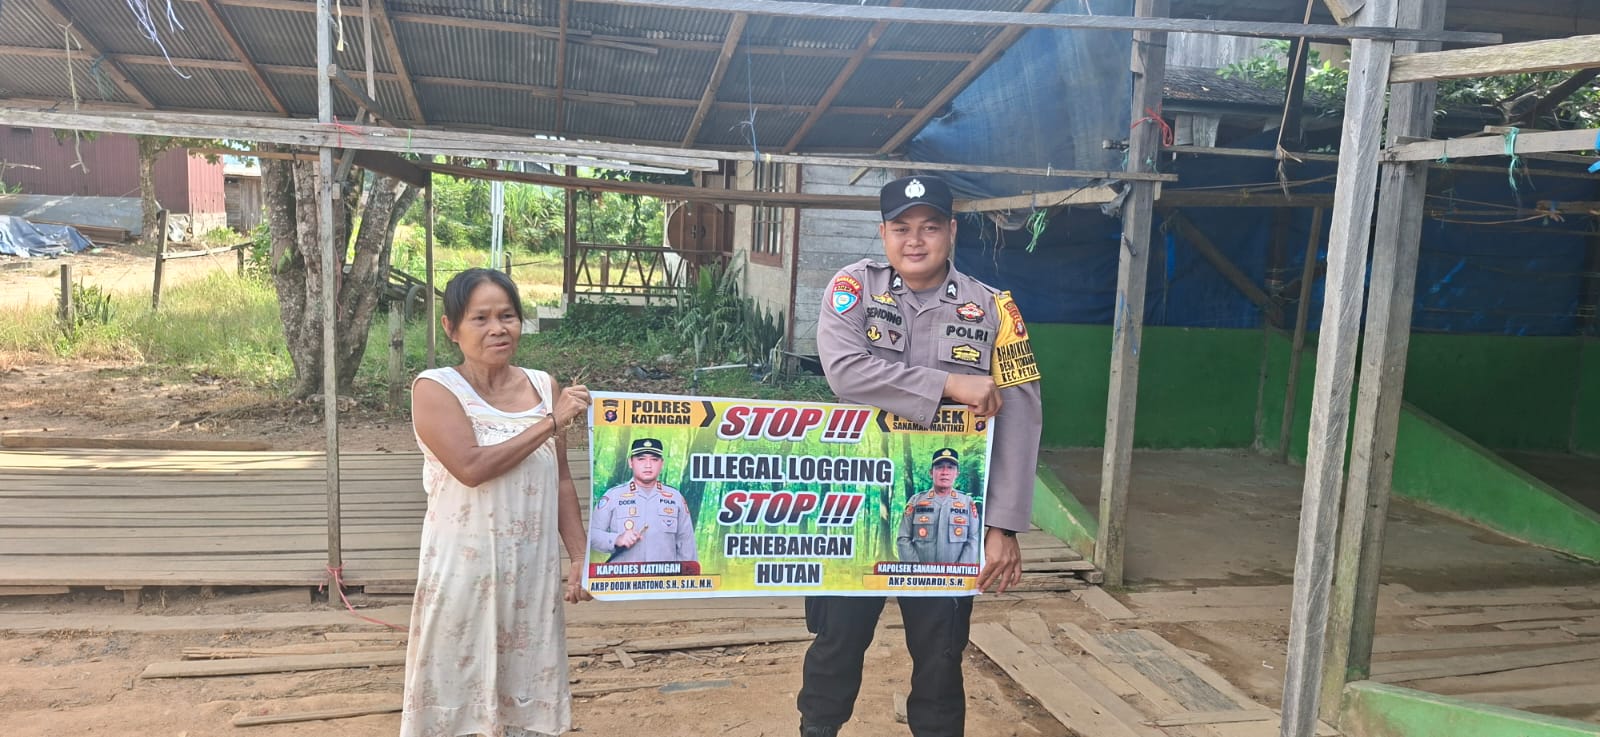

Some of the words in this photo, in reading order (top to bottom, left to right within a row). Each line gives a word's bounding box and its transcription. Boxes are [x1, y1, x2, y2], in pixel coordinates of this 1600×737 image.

[946, 325, 988, 342] POLRI
[999, 360, 1015, 373] DESA
[631, 400, 691, 414] POLRES
[631, 414, 690, 425] KATINGAN
[719, 405, 823, 438] STOP
[824, 409, 872, 439] !!!
[693, 455, 782, 480] ILLEGAL
[788, 457, 892, 483] LOGGING
[719, 492, 817, 524] STOP
[818, 494, 863, 524] !!!
[727, 535, 852, 556] PENEBANGAN
[596, 564, 638, 576] KAPOLRES
[639, 563, 681, 574] KATINGAN
[757, 563, 820, 584] HUTAN
[877, 563, 912, 573] KAPOLSEK
[912, 564, 945, 574] SANAMAN
[945, 565, 978, 575] MANTIKEI
[591, 581, 609, 592] AKBP
[610, 581, 631, 590] DODIK
[888, 577, 905, 586] AKP
[949, 578, 965, 586] S.H.
